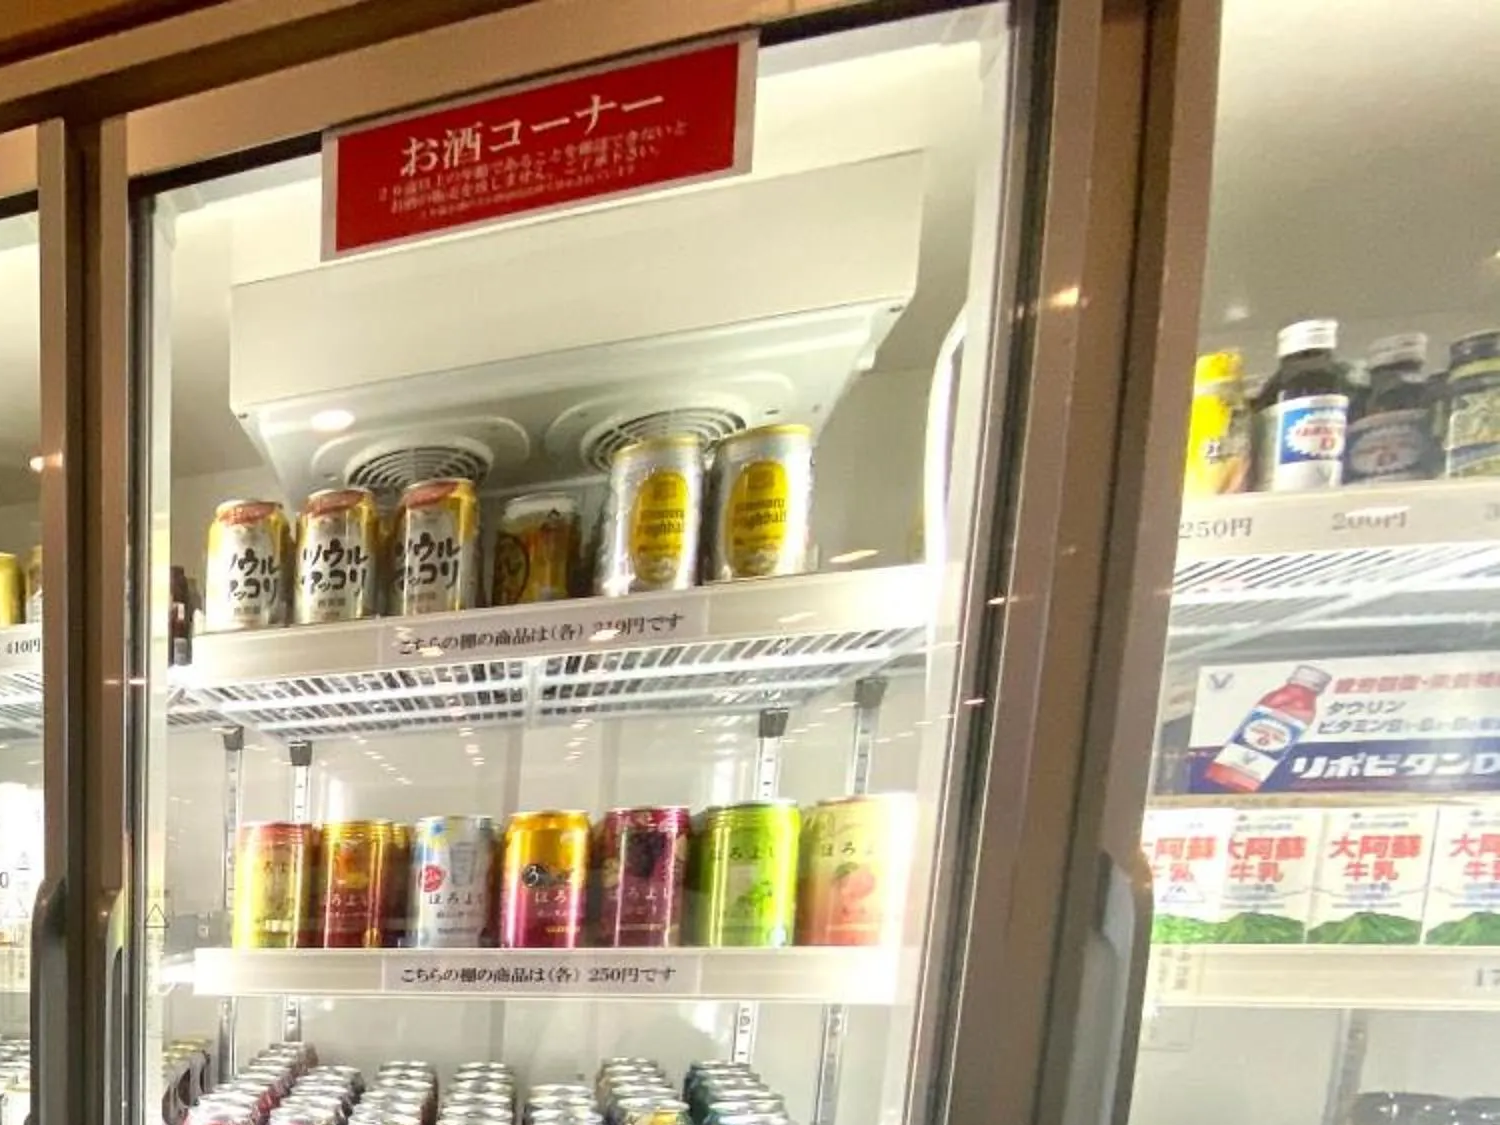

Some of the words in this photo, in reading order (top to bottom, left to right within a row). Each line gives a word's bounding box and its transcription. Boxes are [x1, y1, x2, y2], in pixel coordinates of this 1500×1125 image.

[401, 94, 665, 177] お酒コーナー
[302, 538, 369, 565] ソウル
[1228, 861, 1285, 883] 牛乳
[1342, 860, 1400, 882] 牛乳
